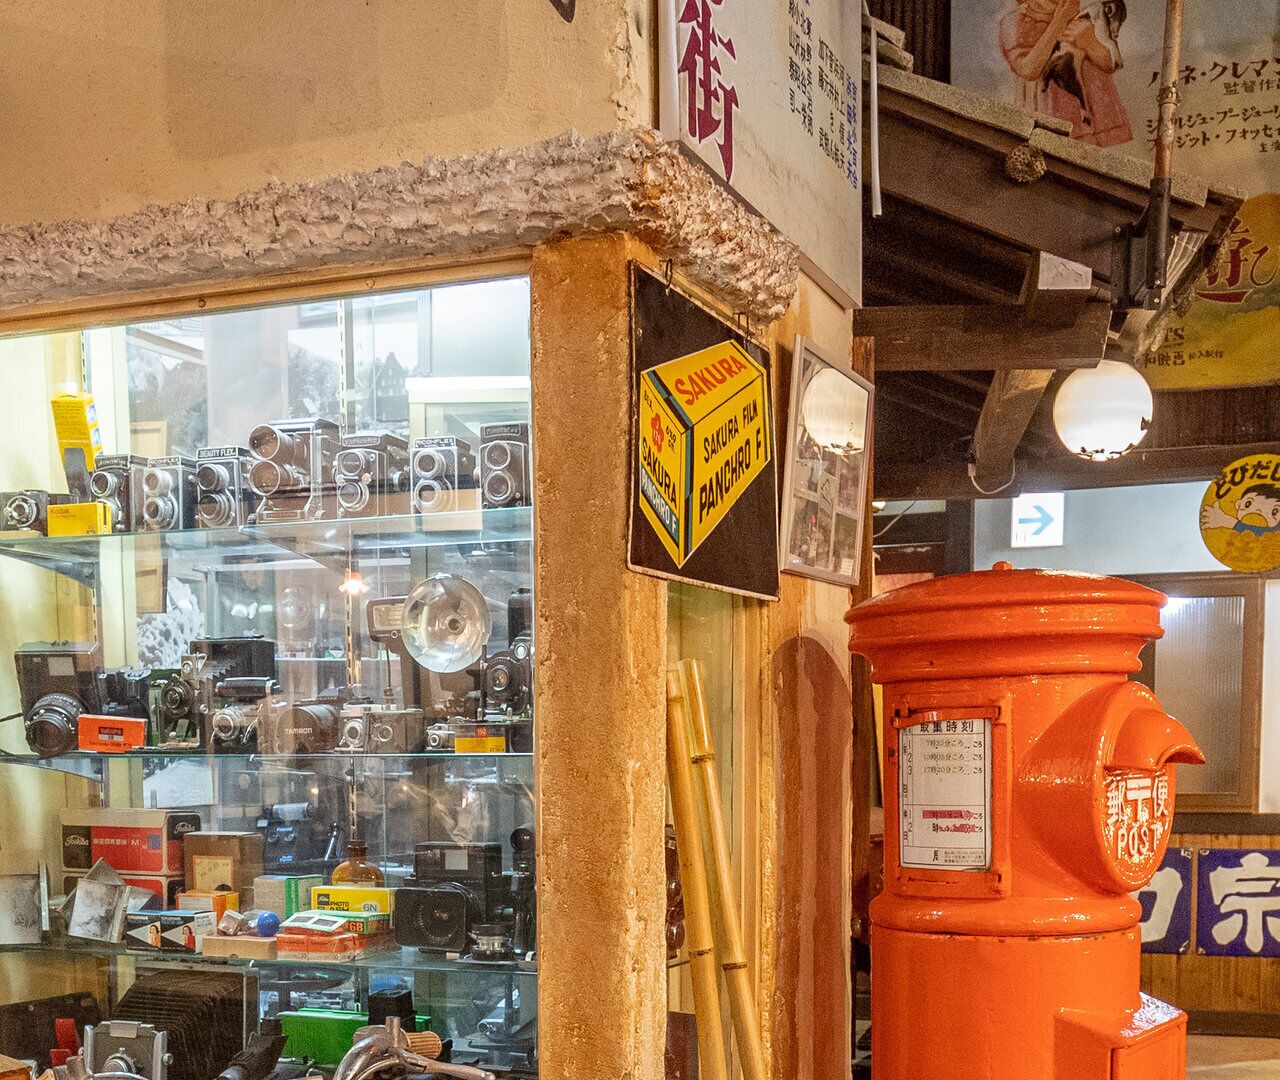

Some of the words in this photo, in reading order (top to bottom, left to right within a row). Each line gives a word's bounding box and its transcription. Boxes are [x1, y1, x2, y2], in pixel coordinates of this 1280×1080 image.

[674, 355, 747, 406] SAKURA
[703, 413, 740, 463] SAKURA
[742, 398, 758, 427] FILM
[199, 449, 220, 458] BEAUTY
[642, 436, 677, 509] SAKURA
[699, 445, 751, 524] PANCHRO
[756, 429, 762, 461] F
[641, 467, 670, 525] PANCHRO
[671, 515, 677, 534] F
[284, 727, 312, 735] TAMRON
[920, 720, 974, 733] 取集時刻
[1117, 822, 1162, 859] POST
[363, 903, 378, 912] 6N
[349, 922, 364, 932] 6B
